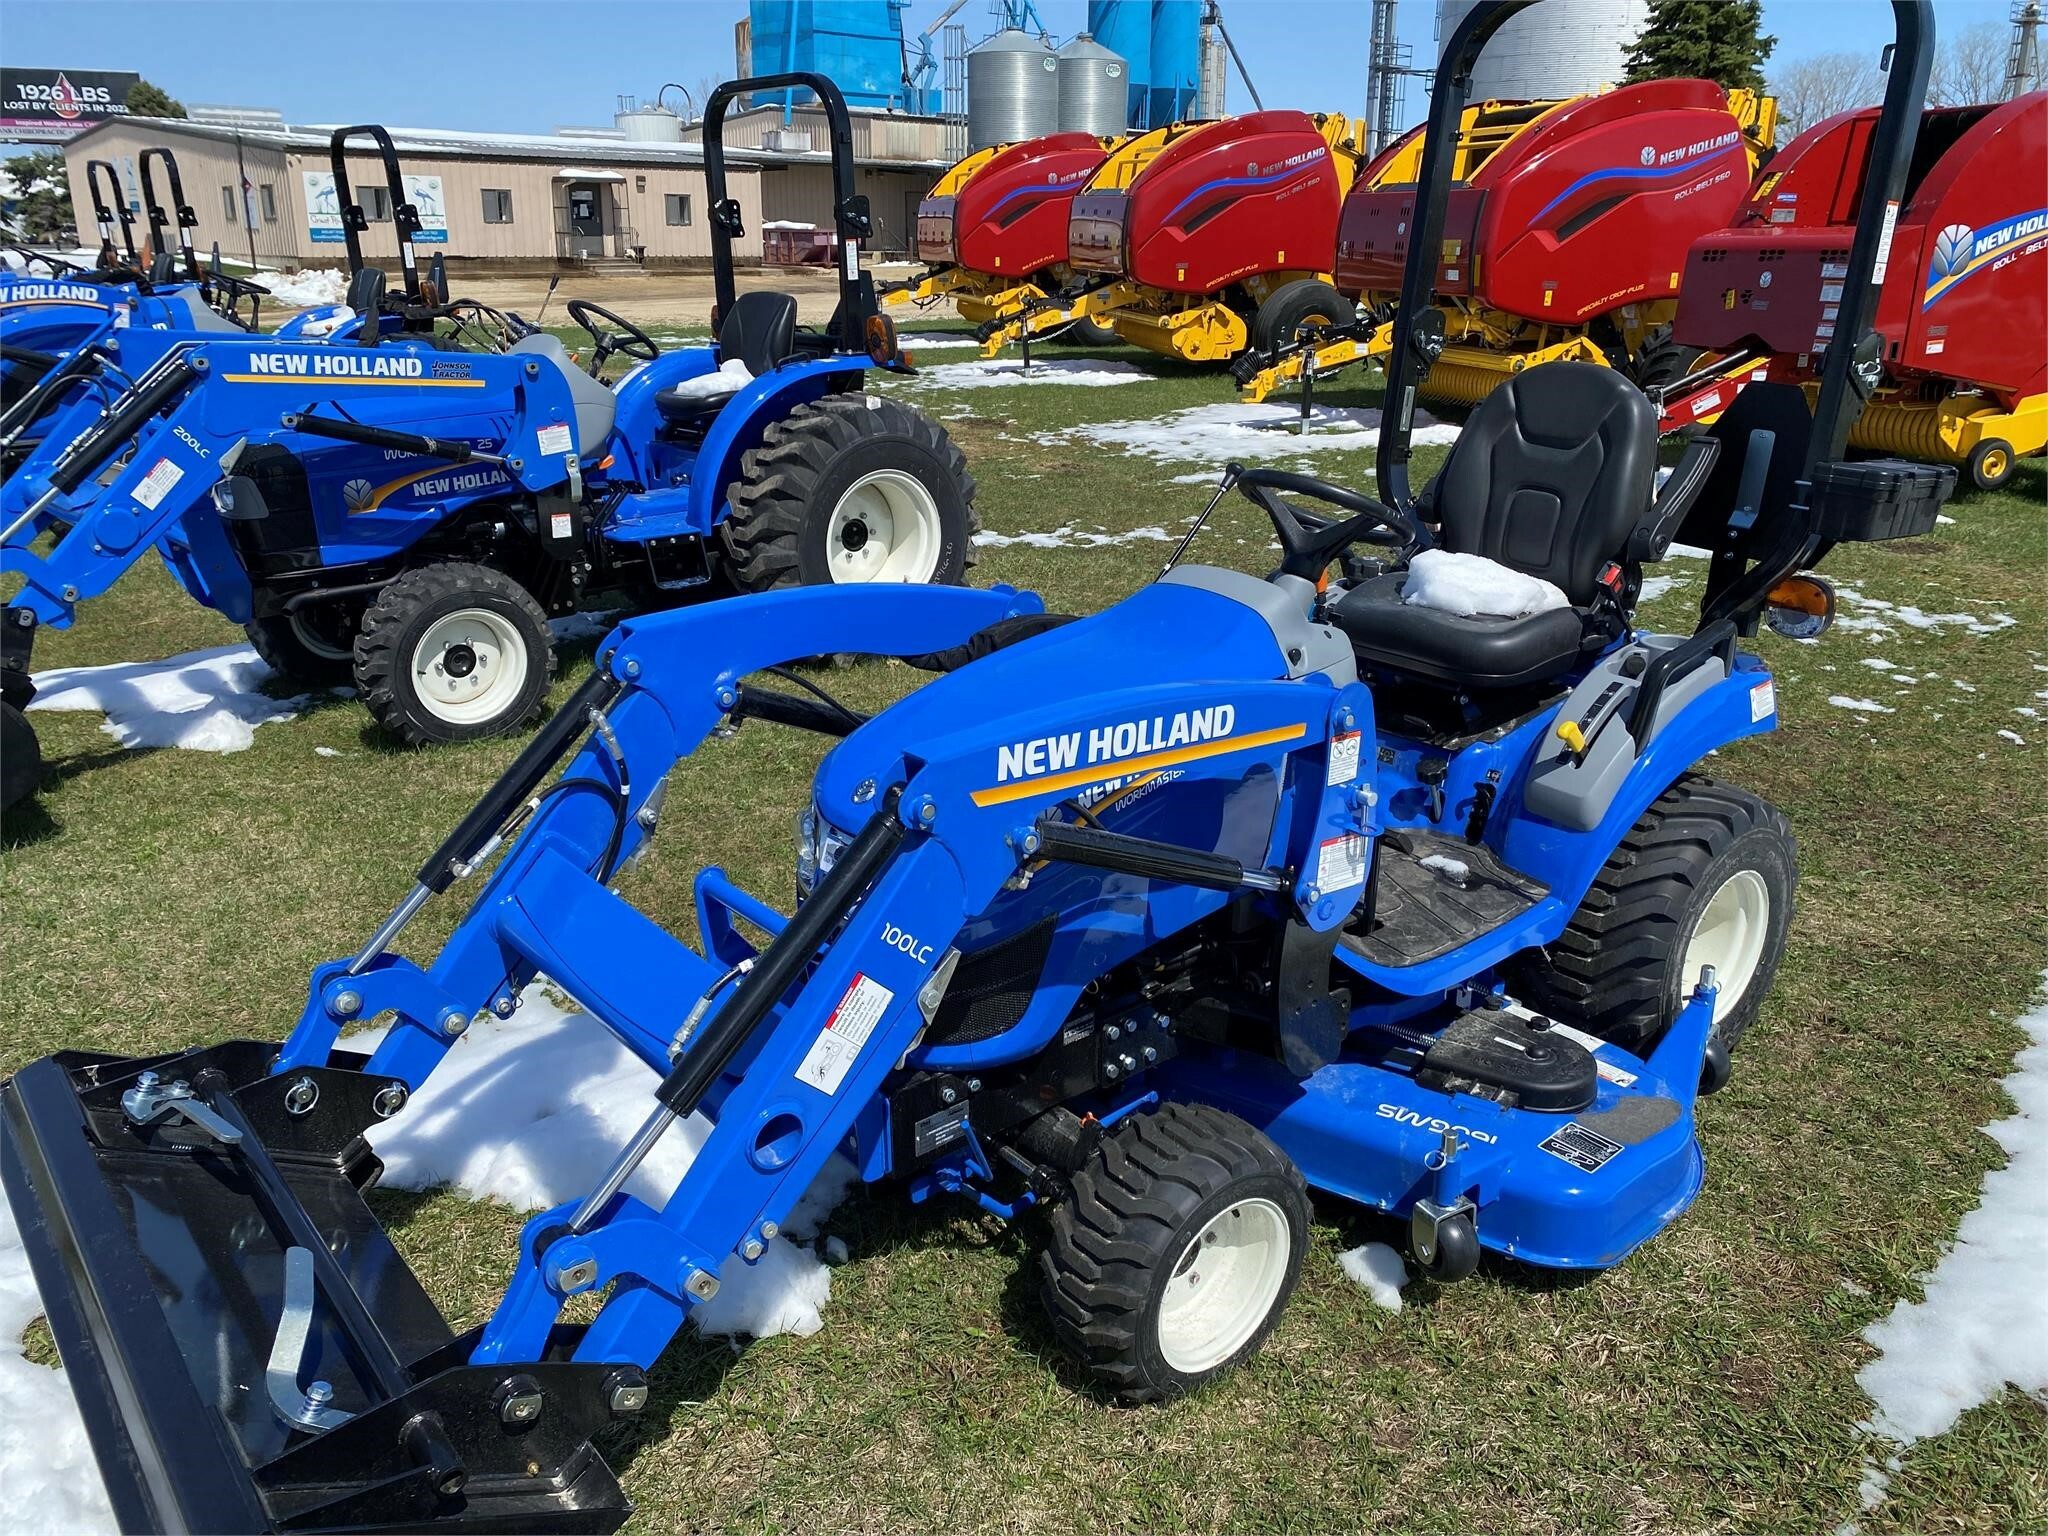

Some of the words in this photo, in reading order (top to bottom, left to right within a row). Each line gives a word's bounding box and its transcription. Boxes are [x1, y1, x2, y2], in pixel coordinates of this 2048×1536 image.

[16, 84, 65, 101] 1926
[70, 86, 111, 103] LBS
[3, 100, 30, 110] LOST
[32, 101, 47, 111] BY
[48, 102, 91, 113] CLIENTS
[92, 103, 104, 112] IN
[15, 127, 65, 136] CHIROPRACTIC
[1659, 147, 1687, 166] NEW
[1688, 131, 1740, 157] HOLLAND
[1262, 161, 1283, 176] NEW
[1284, 146, 1326, 168] HOLLAND
[1060, 172, 1077, 184] NEW
[1673, 177, 1714, 201] ROLL-BELT
[1974, 225, 2014, 257] NEW
[1992, 253, 2018, 272] ROLL
[2025, 238, 2048, 256] BELT
[12, 284, 99, 302] HOLLAND
[1576, 296, 1609, 316] SPECIALTY
[1608, 289, 1627, 300] CROP
[1627, 283, 1645, 294] PLUS
[249, 352, 308, 375] NEW
[313, 355, 423, 377] HOLLAND
[431, 360, 472, 370] JOHNSON
[431, 369, 472, 379] TRACTOR
[172, 425, 211, 459] 200LC
[477, 438, 493, 450] 25
[412, 478, 450, 497] NEW
[997, 732, 1081, 782] NEW
[1087, 704, 1236, 764] HOLLAND
[880, 921, 934, 965] 100LC
[837, 985, 854, 1008] DANGER
